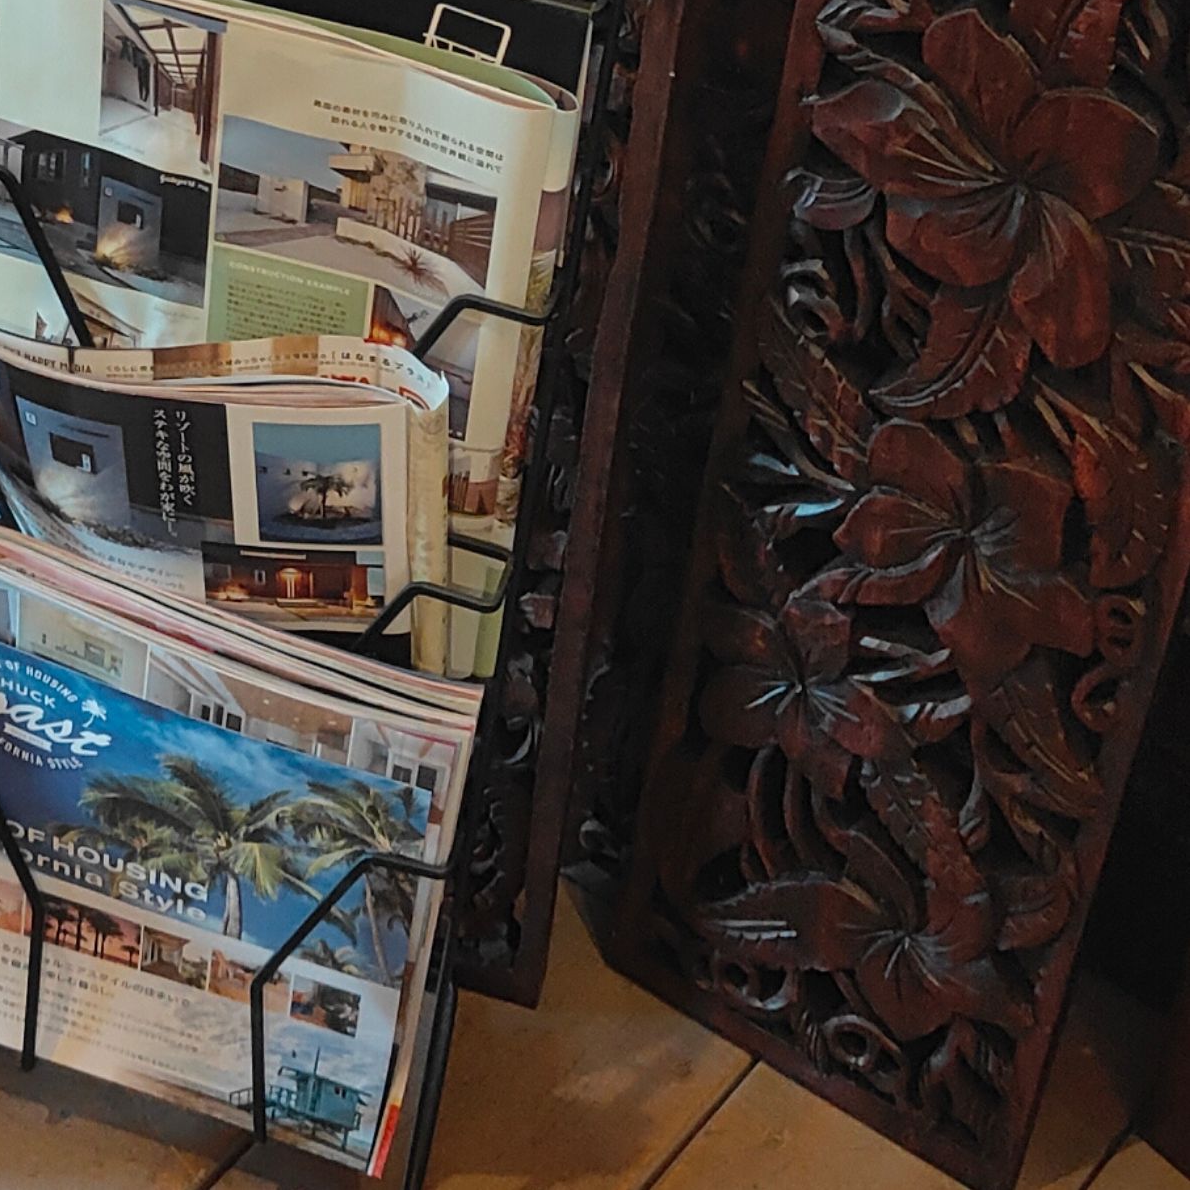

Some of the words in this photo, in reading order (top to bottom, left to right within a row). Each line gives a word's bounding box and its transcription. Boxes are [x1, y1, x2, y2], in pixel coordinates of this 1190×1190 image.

[59, 361, 92, 373] MDIA
[175, 410, 197, 507] リゾートの風が吹く
[0, 678, 57, 709] HUCK
[5, 659, 21, 672] OF
[26, 665, 79, 703] HOUSING
[46, 756, 84, 771] STYLE
[53, 835, 209, 902] HOUSING
[119, 880, 207, 922] Style
